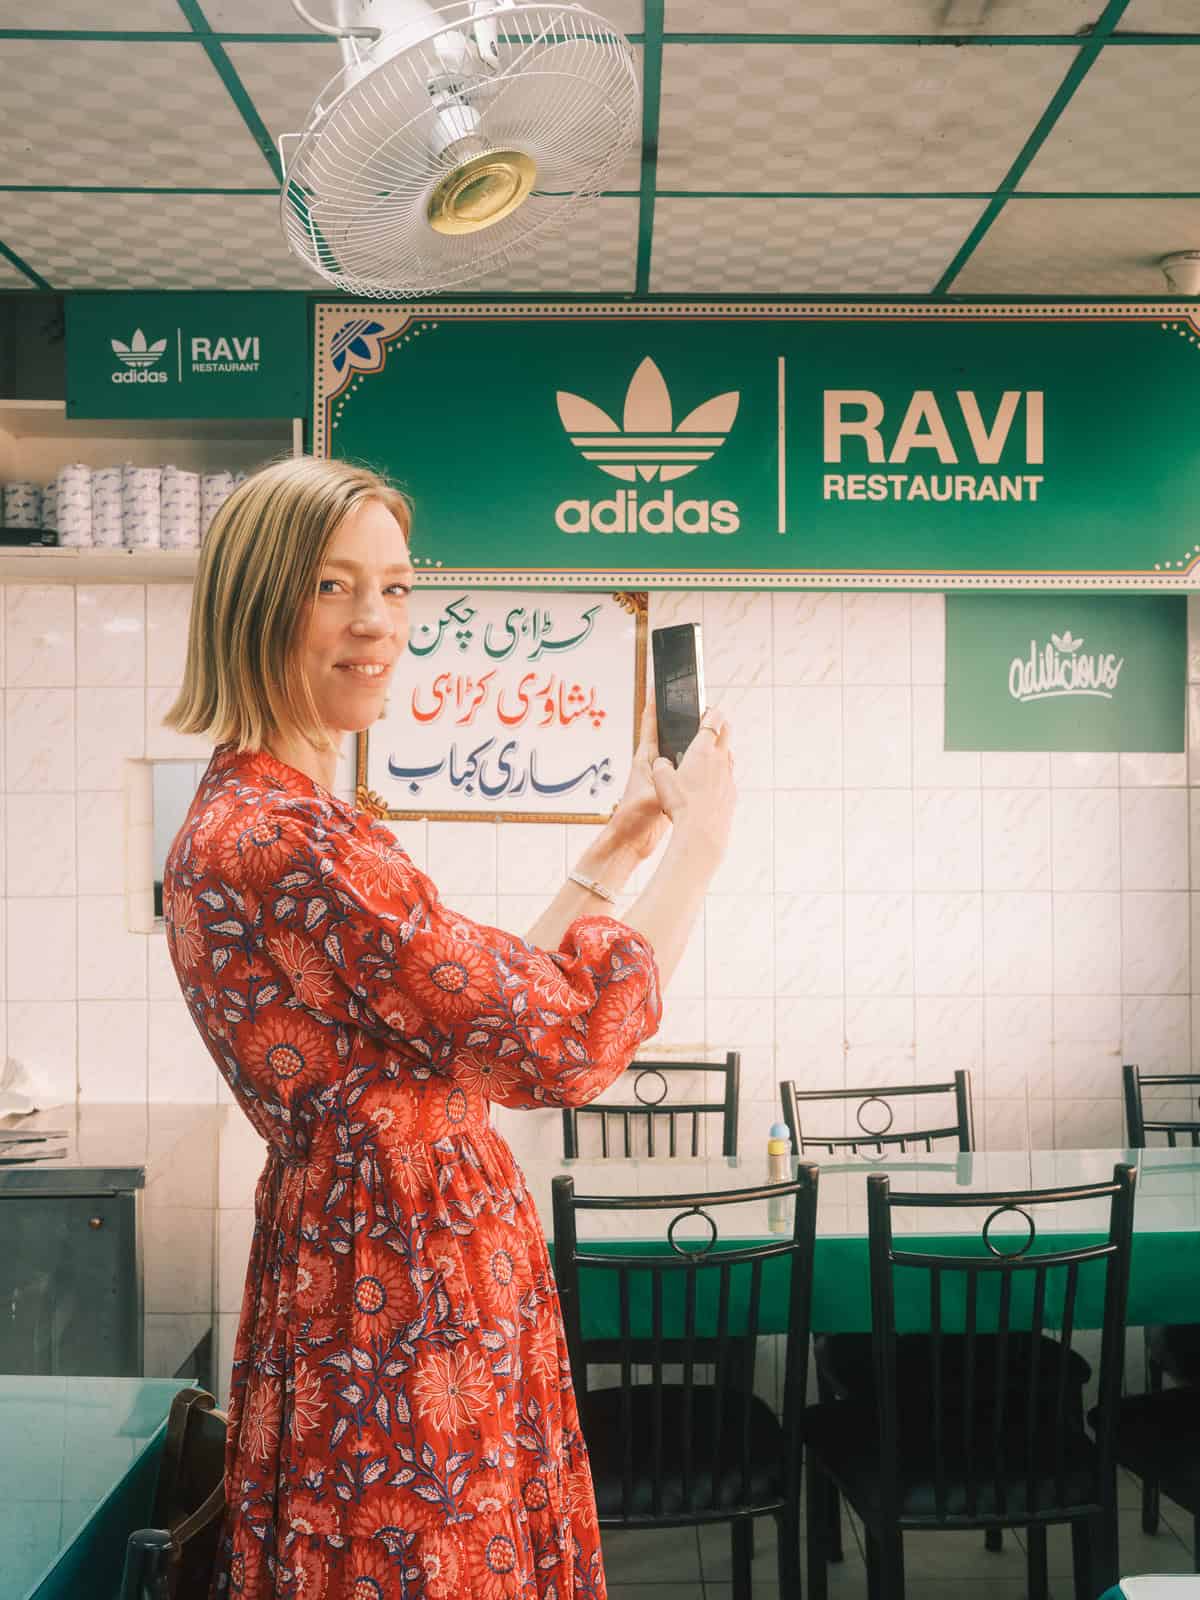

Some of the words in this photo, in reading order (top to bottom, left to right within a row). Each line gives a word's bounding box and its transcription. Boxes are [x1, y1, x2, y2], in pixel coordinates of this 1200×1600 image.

[111, 369, 168, 384] adidas
[192, 337, 260, 361] RAVI
[192, 363, 259, 372] RESTAURANT
[823, 389, 1044, 465] RAVI
[555, 489, 741, 535] adidas
[823, 474, 1044, 502] RESTAURANT
[407, 594, 477, 657] چکن
[484, 605, 601, 660] کڑاہی
[1008, 639, 1124, 699] adilicious
[411, 670, 497, 725] کڑاہی
[496, 672, 607, 728] پشاوری
[388, 737, 497, 794] کباب
[479, 740, 612, 798] بہاری
